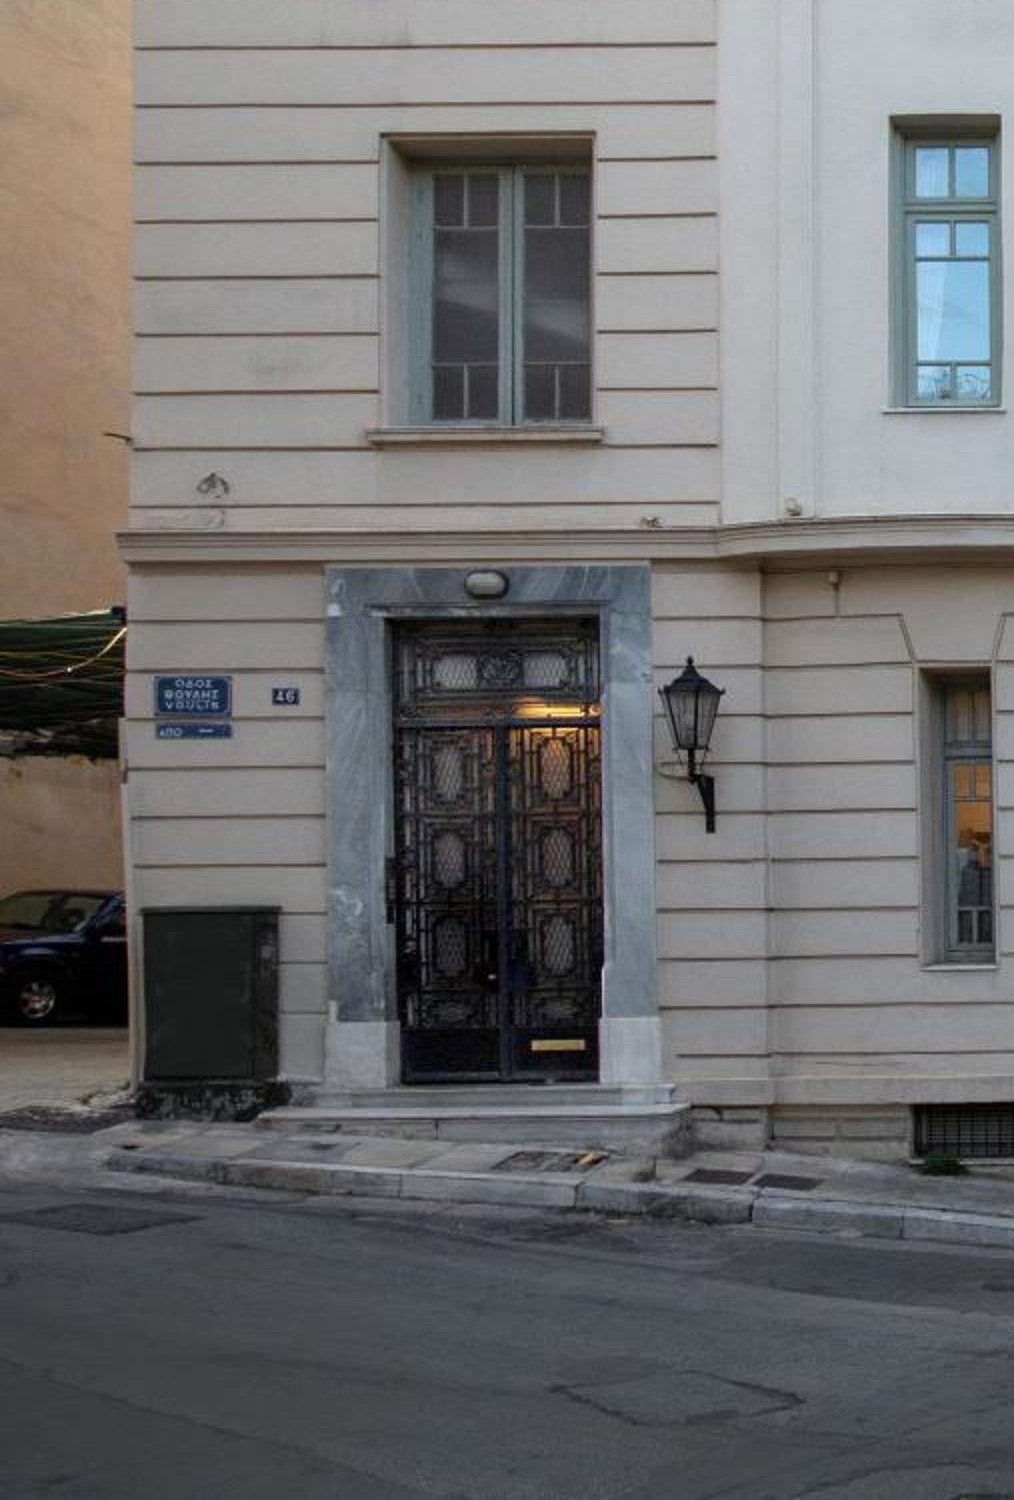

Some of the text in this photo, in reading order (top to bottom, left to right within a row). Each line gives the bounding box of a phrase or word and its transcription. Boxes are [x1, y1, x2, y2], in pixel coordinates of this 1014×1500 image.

[175, 679, 213, 689] ΟΔΟΣ
[164, 690, 220, 700] ΒΟΥΛΗΣ
[276, 690, 295, 702] 46
